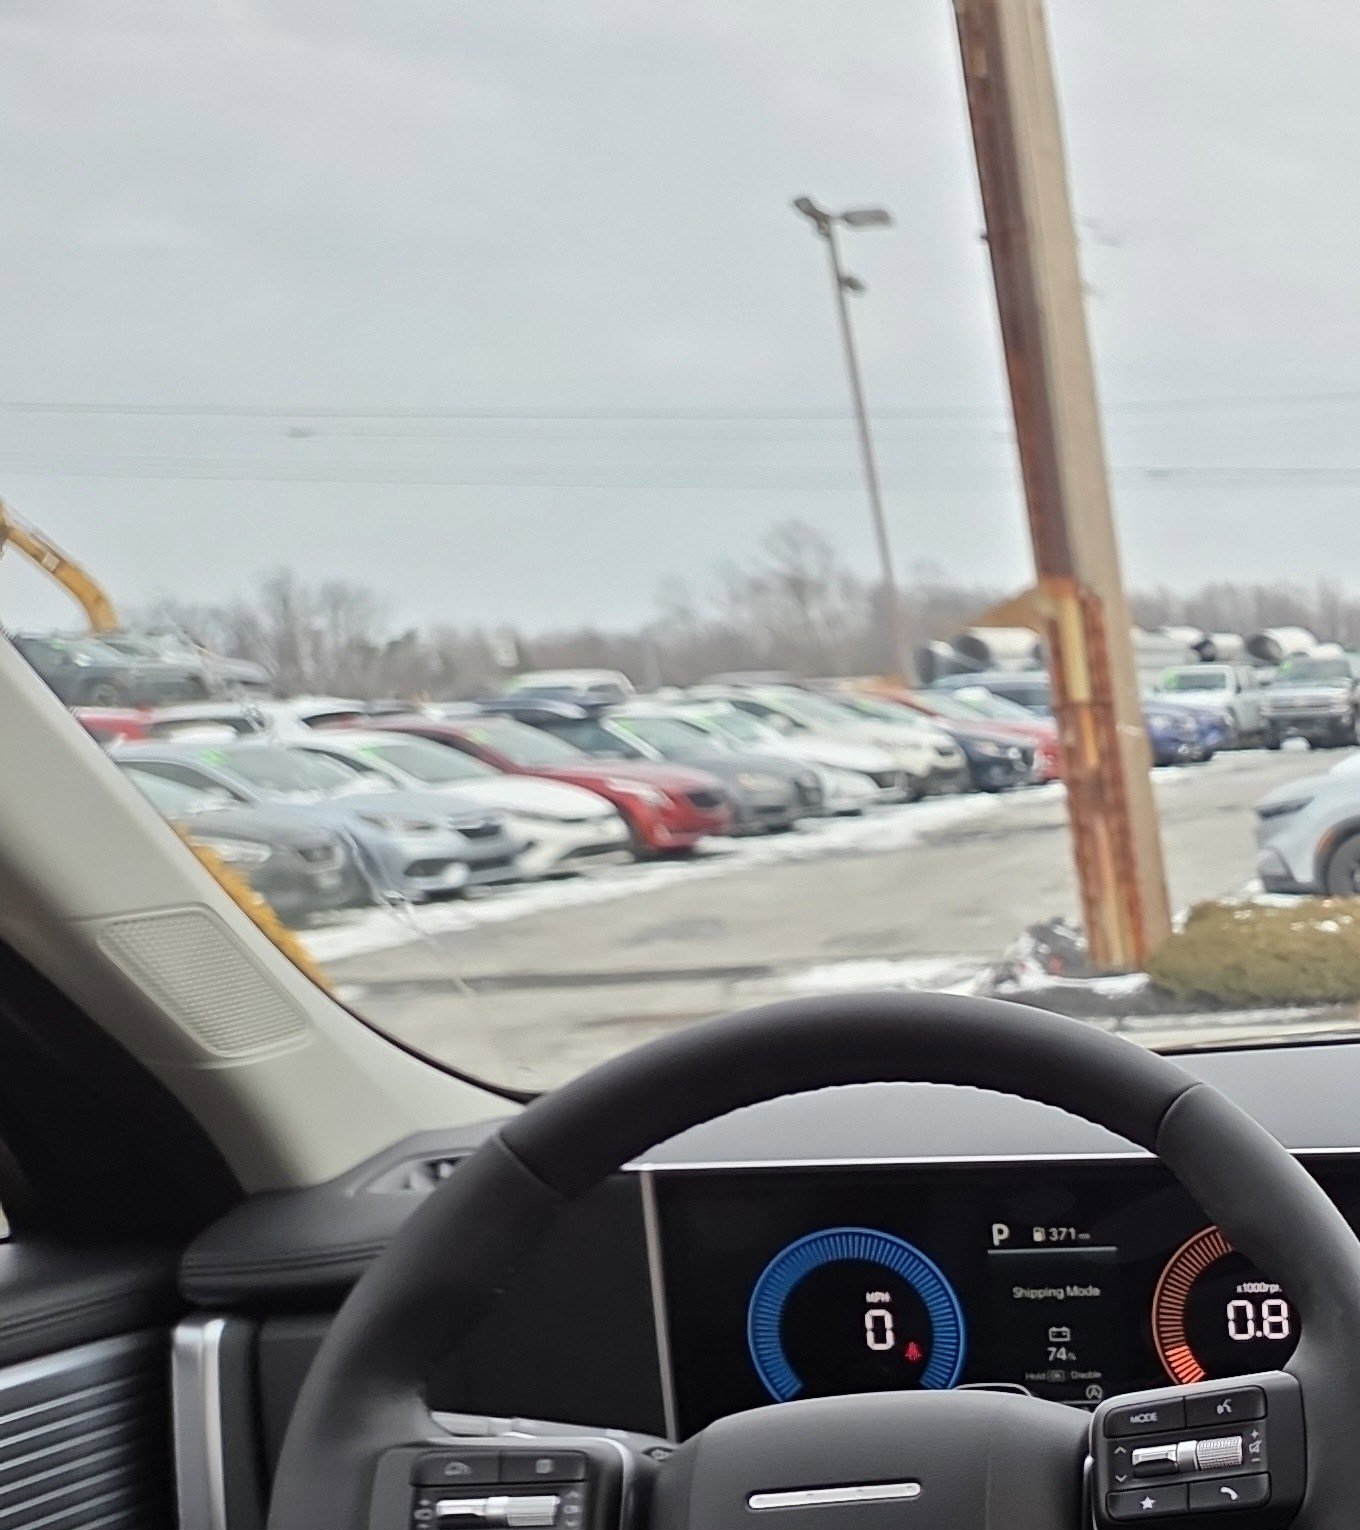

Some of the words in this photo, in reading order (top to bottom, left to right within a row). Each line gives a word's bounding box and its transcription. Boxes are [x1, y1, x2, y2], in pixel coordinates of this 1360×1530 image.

[991, 1223, 1010, 1246] P
[1049, 1227, 1076, 1241] 371
[1012, 1286, 1065, 1300] Shipping
[1066, 1285, 1101, 1297] Mode
[1227, 1298, 1290, 1341] 0.8
[864, 1308, 895, 1351] 0
[1130, 1412, 1158, 1424] MODE
